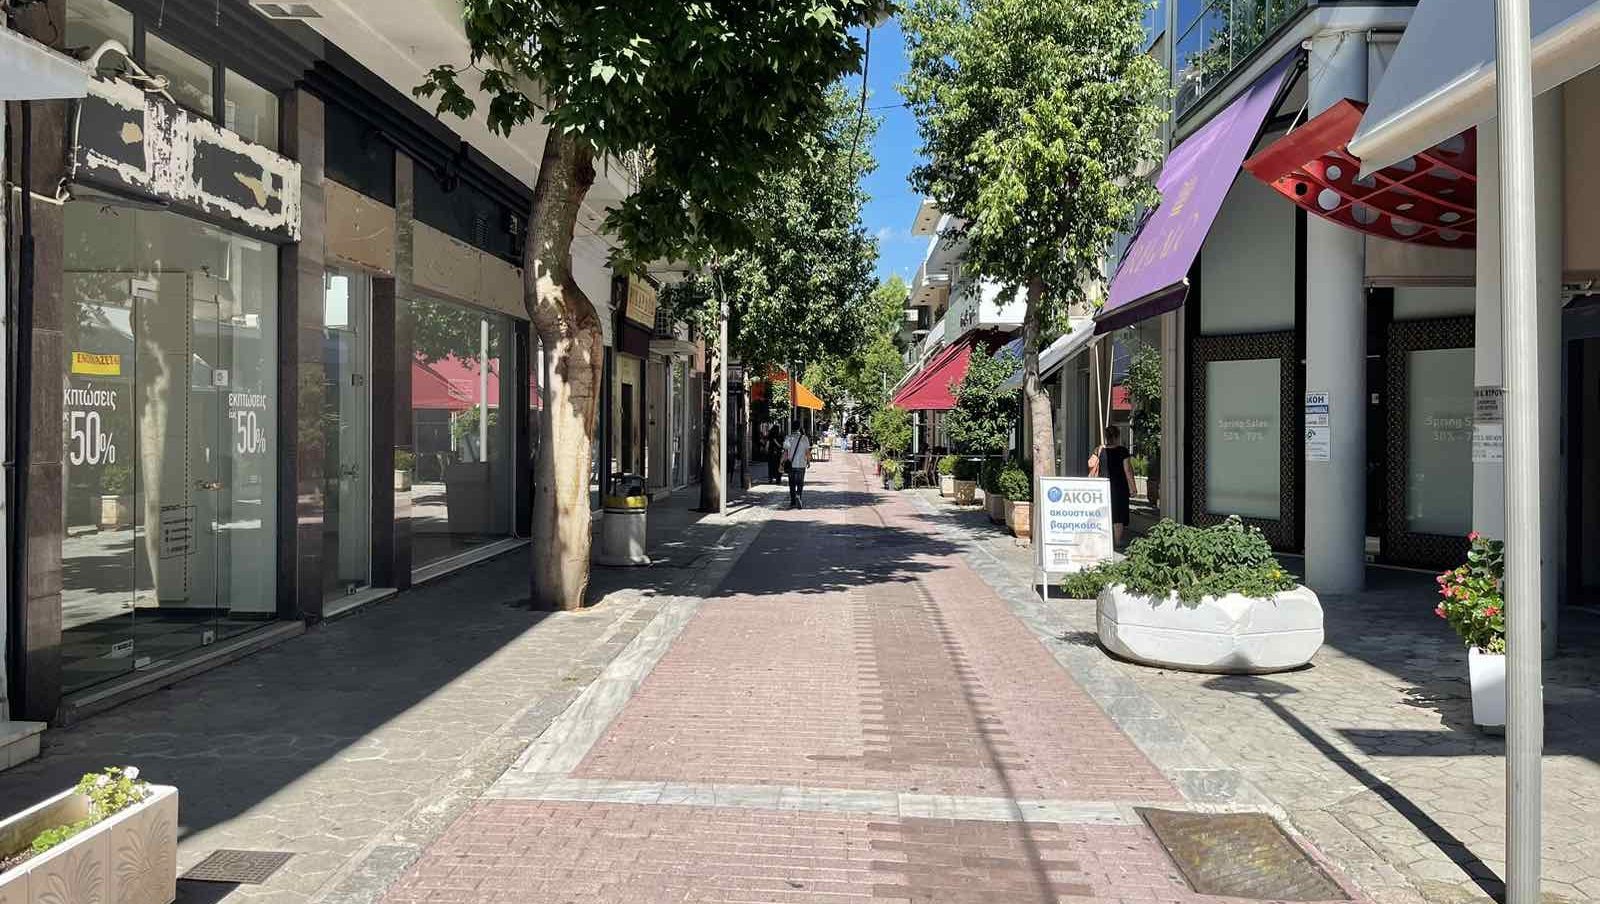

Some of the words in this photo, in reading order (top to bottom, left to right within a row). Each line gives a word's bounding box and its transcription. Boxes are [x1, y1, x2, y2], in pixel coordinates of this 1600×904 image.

[228, 388, 267, 411] εκπτώσεις
[70, 410, 116, 466] 50%
[237, 410, 266, 454] 50%
[1062, 492, 1103, 503] ΑΚΟΗ
